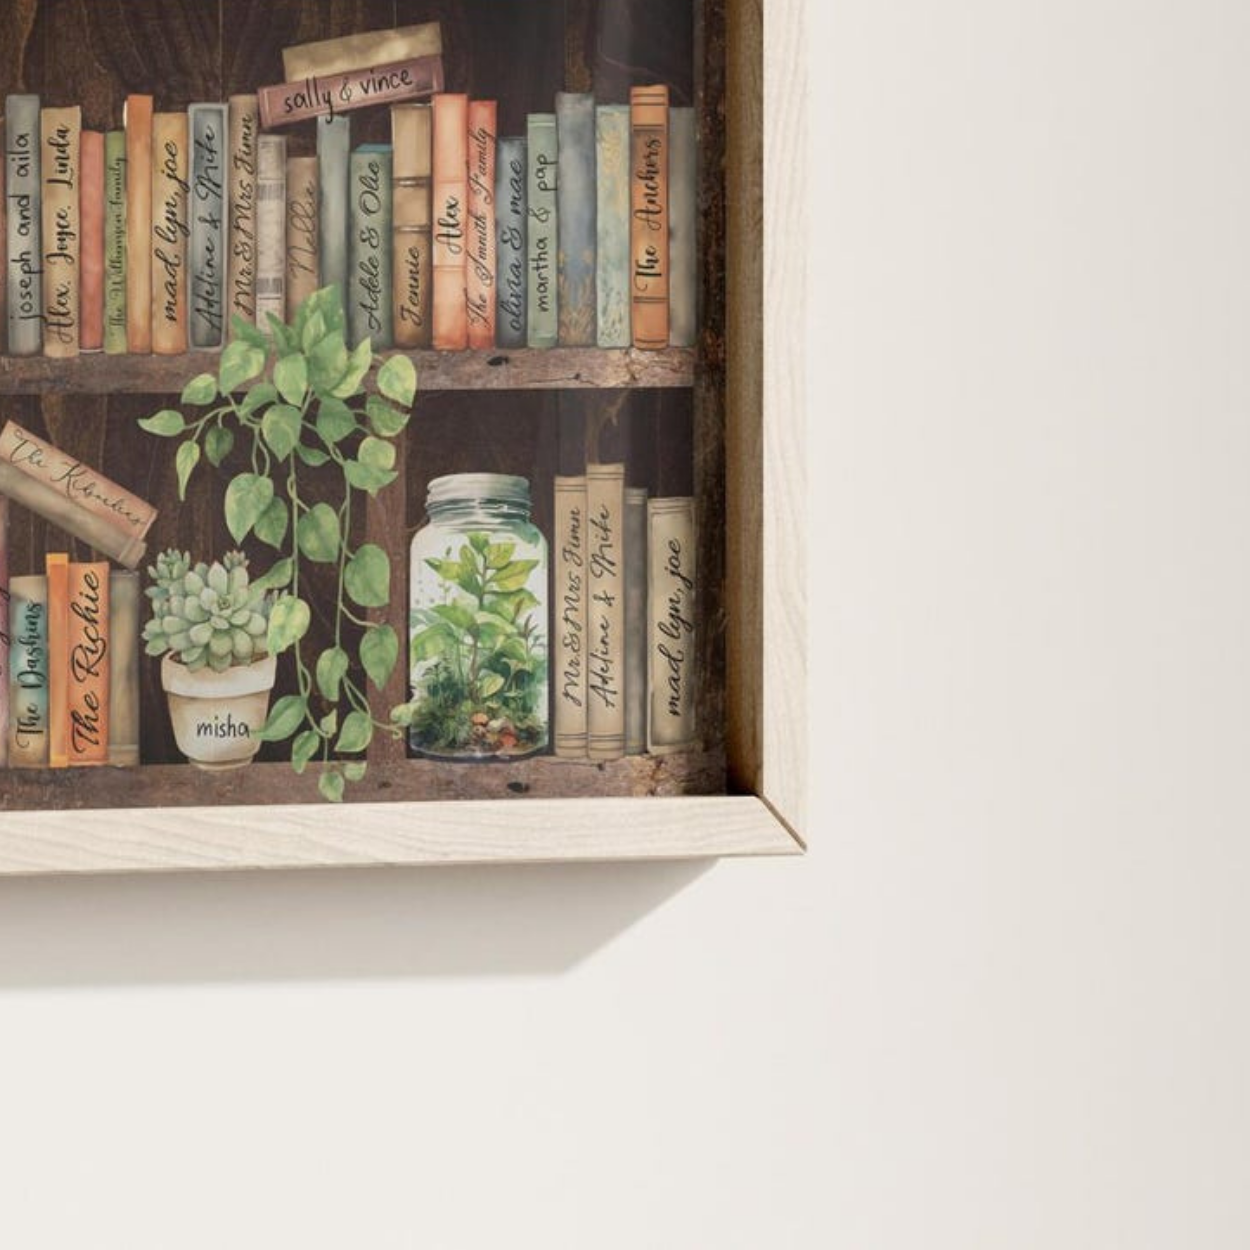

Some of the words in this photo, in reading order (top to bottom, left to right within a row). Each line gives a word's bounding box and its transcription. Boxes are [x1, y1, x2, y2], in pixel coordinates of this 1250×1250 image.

[284, 76, 333, 124] sally
[339, 80, 354, 101] &
[359, 68, 413, 95] vince
[7, 133, 29, 177] aila
[47, 125, 73, 189] Linda
[537, 153, 557, 192] pap
[8, 194, 30, 236] and
[510, 159, 522, 216] mae
[527, 206, 550, 223] &
[359, 226, 380, 249] &
[435, 195, 463, 255] Alex
[501, 224, 522, 250] &
[10, 251, 47, 321] joseph
[359, 258, 381, 332] Adele
[399, 246, 421, 325] Jennie
[500, 258, 522, 332] olivia
[529, 236, 548, 313] martha
[664, 538, 693, 589] joe
[70, 570, 106, 683] Richie
[16, 702, 43, 748] The
[70, 690, 100, 754] The
[197, 714, 249, 738] misha
